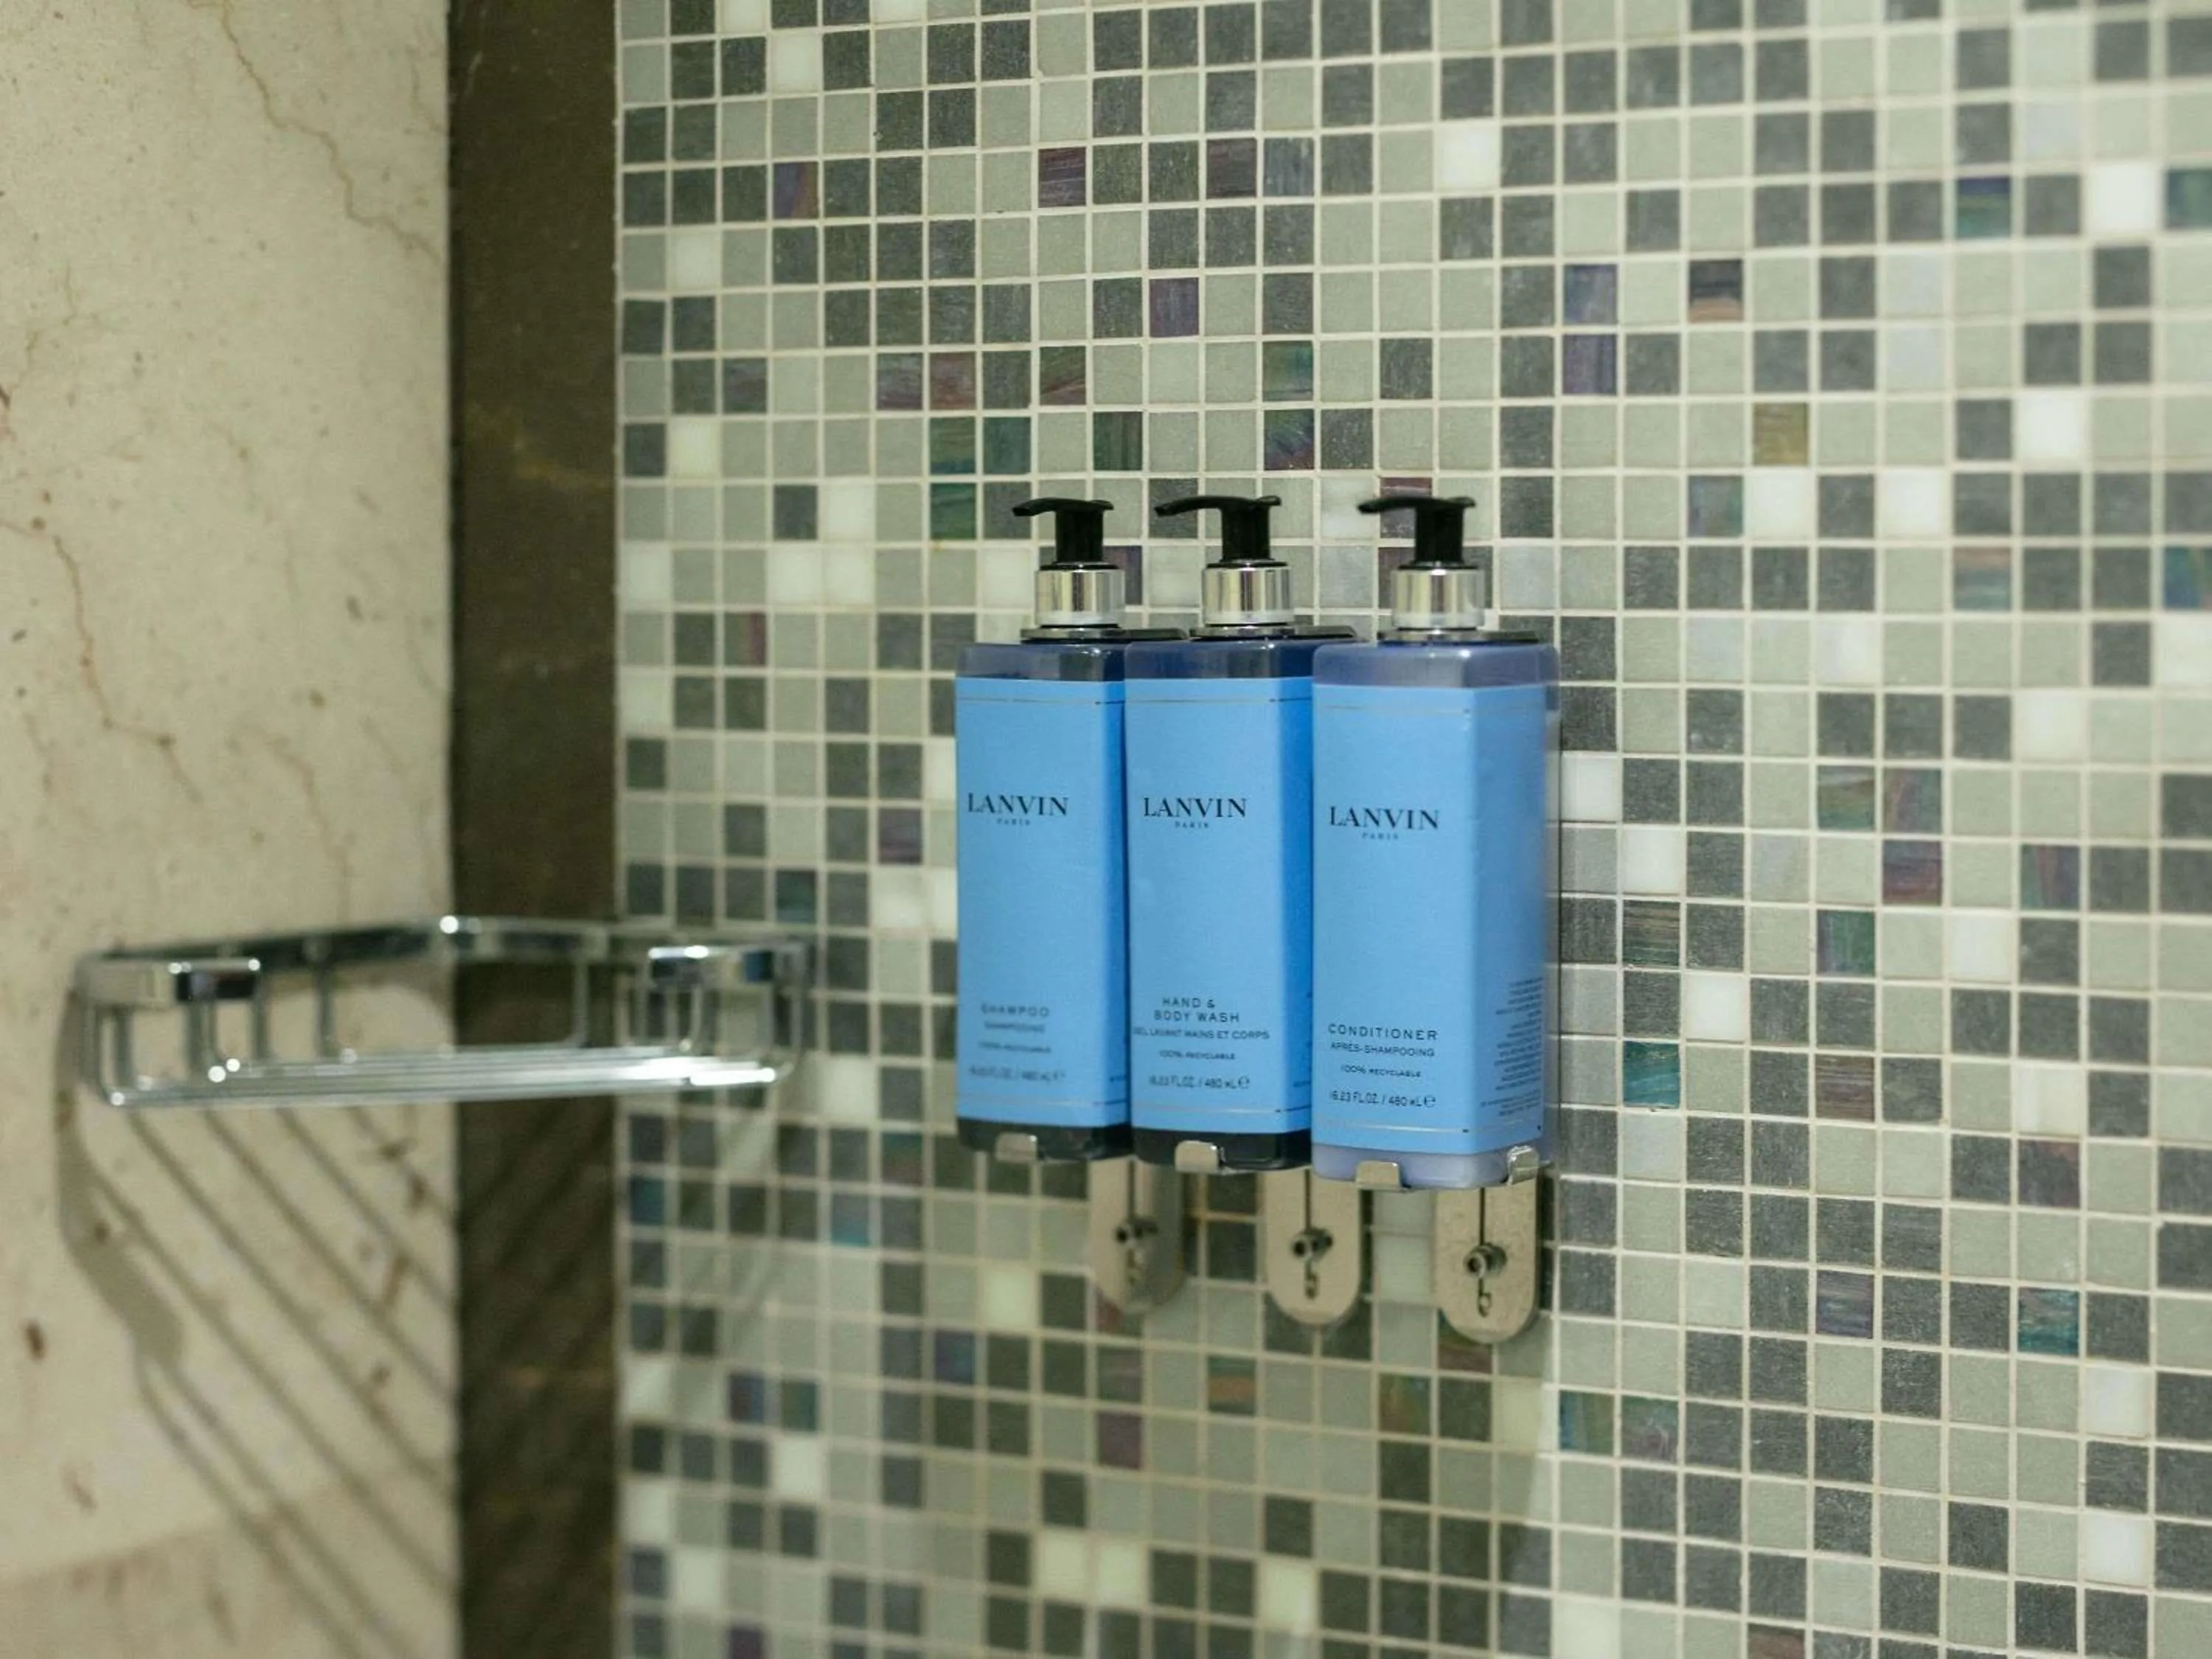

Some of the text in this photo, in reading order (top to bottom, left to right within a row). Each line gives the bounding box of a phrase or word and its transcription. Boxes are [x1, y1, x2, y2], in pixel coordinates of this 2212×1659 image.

[967, 792, 1068, 816] LANVIN
[1144, 797, 1247, 818] LANVIN
[1330, 806, 1439, 830] LANVIN
[1162, 998, 1216, 1009] HAND &
[1154, 1009, 1239, 1023] BODY WASH
[1328, 1023, 1438, 1040] CONDITIONER
